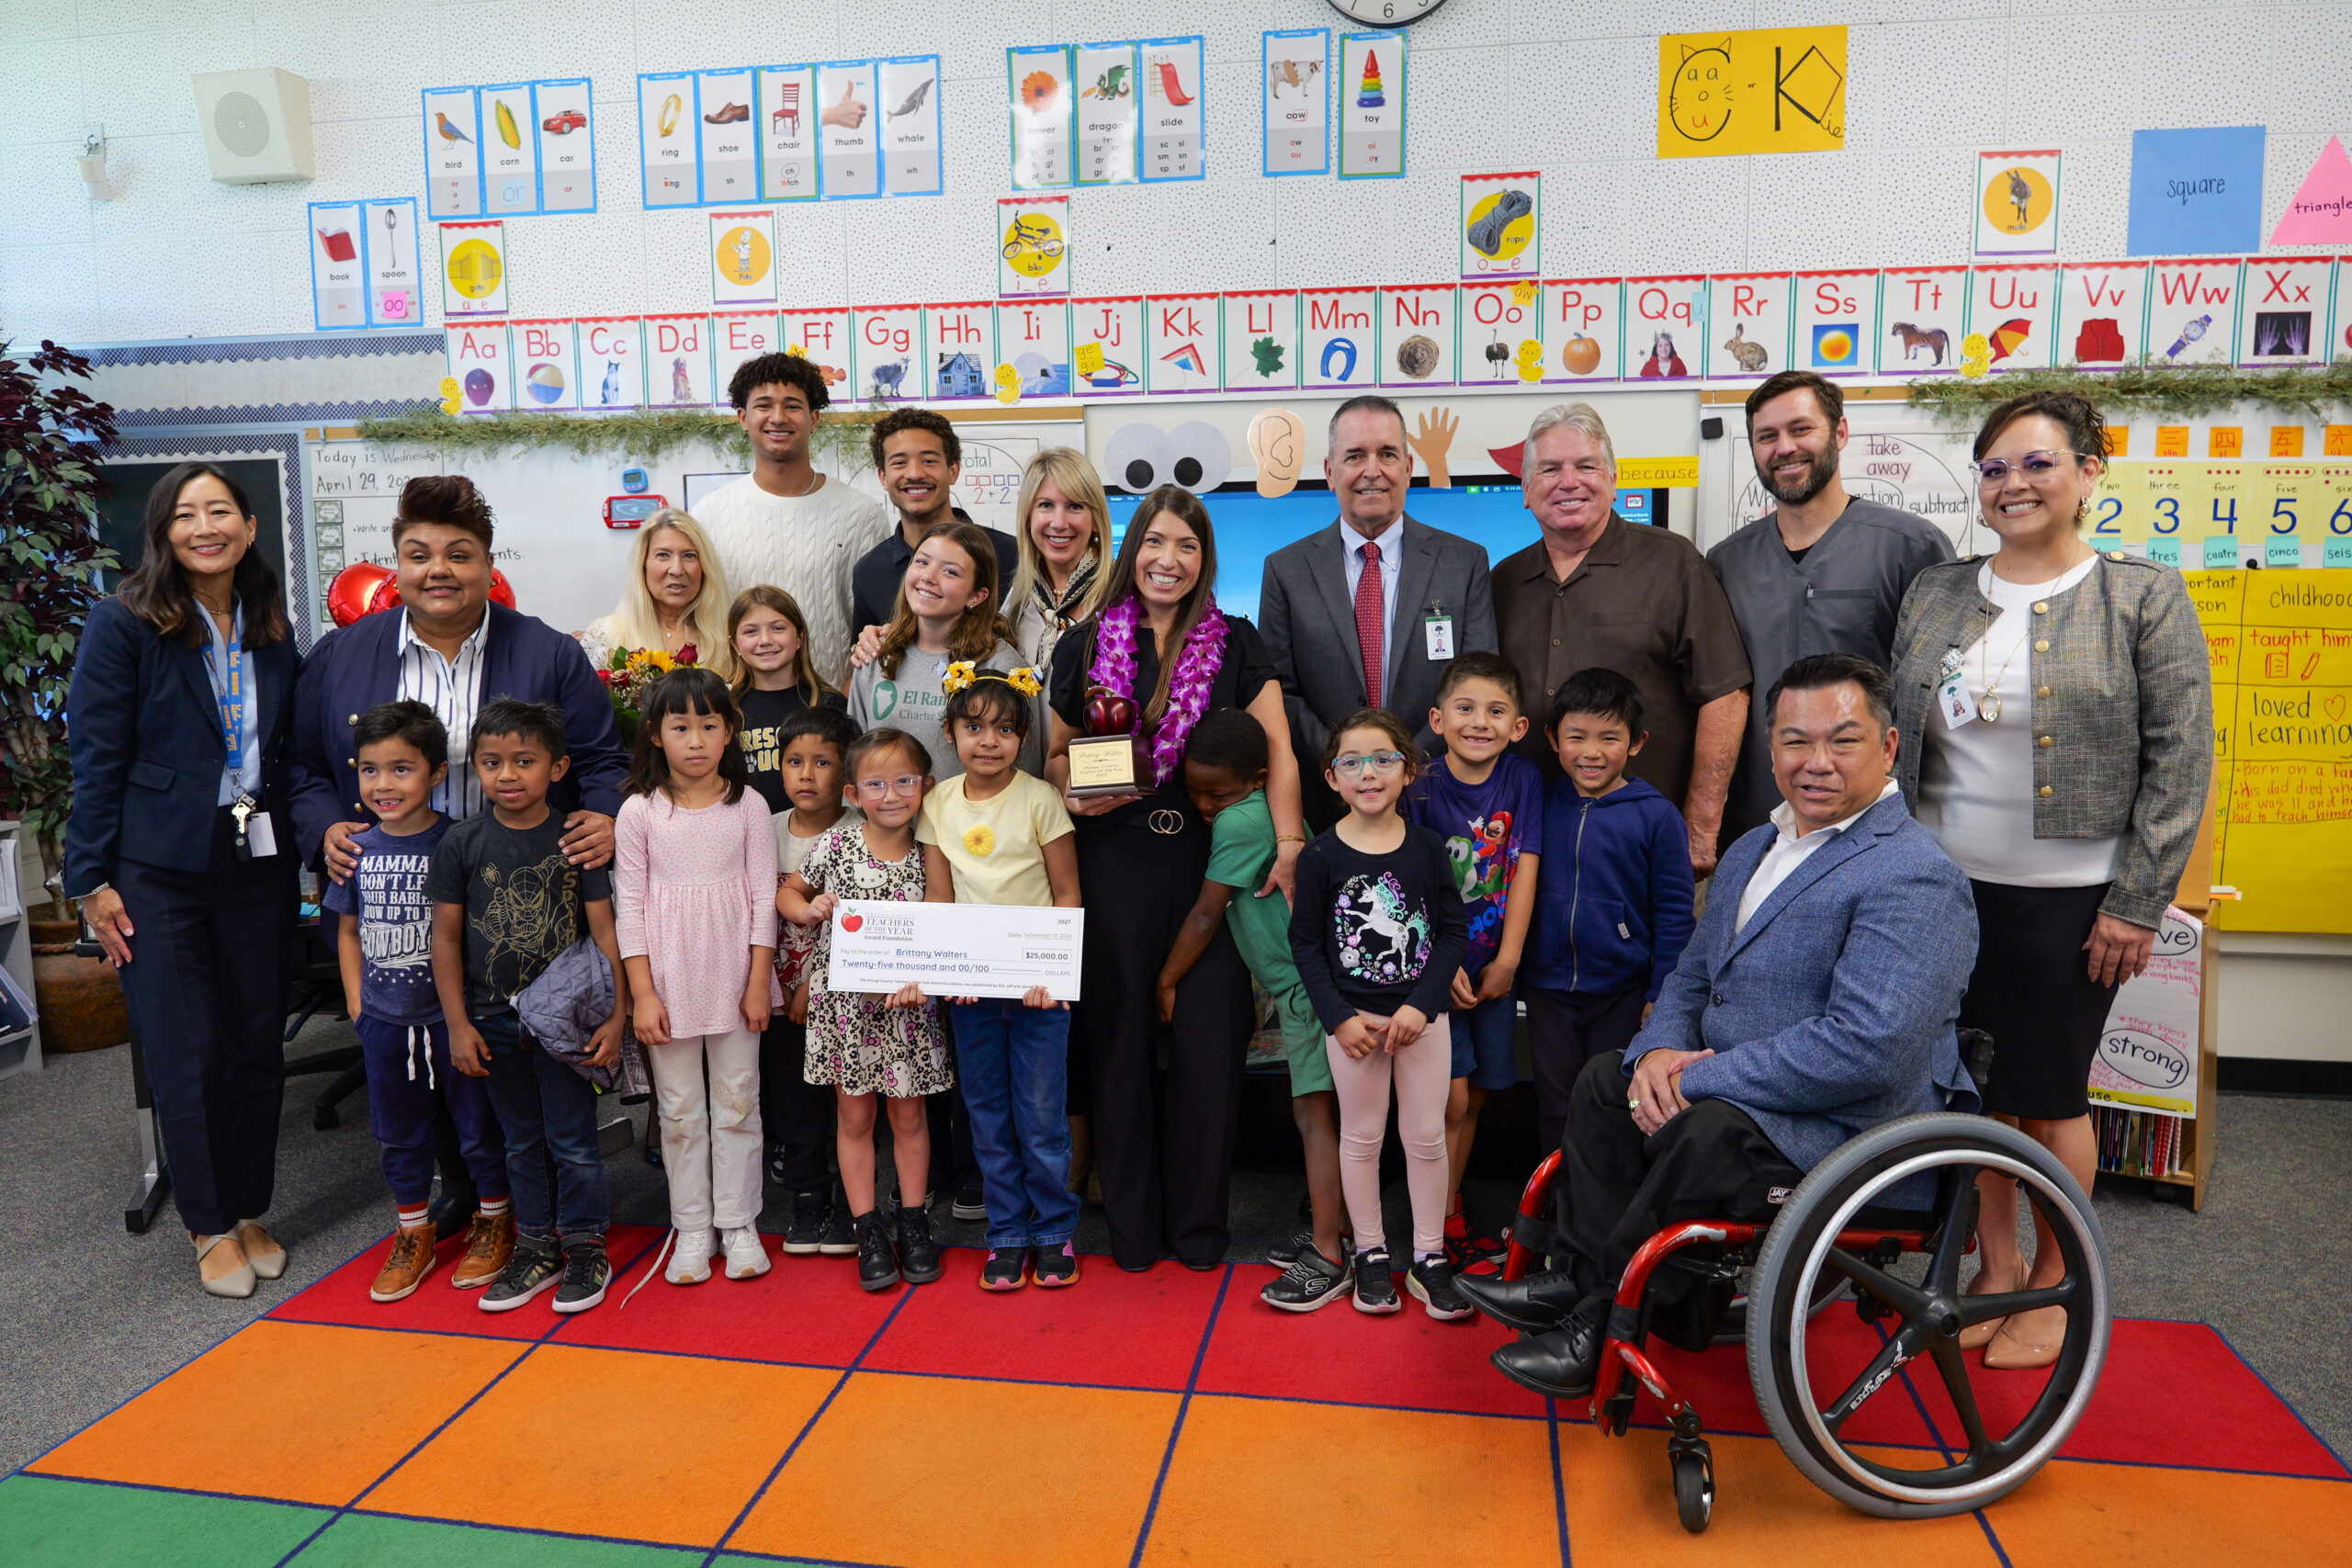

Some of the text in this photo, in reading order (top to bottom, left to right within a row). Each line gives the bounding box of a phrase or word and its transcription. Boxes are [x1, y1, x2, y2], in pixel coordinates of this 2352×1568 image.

[1383, 2, 1395, 18] 6
[1159, 118, 1183, 127] slide
[1286, 112, 1306, 120] cow
[1364, 113, 1381, 124] toy
[1089, 121, 1125, 131] dragon
[777, 141, 800, 151] chair
[835, 138, 864, 147] thumb
[898, 134, 925, 143] whale
[1290, 139, 1303, 147] ow
[662, 149, 679, 158] ring
[718, 143, 739, 153] shoe
[1158, 152, 1188, 161] sm sn
[445, 161, 462, 169] bird
[500, 158, 520, 166] corn
[560, 154, 574, 163] car
[785, 167, 795, 175] ch
[846, 169, 854, 177] th
[1159, 164, 1170, 174] sp
[503, 185, 526, 202] or
[2165, 175, 2227, 206] square
[2293, 194, 2352, 219] triangle
[2007, 223, 2028, 232] mule
[1506, 235, 1526, 246] rope
[330, 273, 350, 281] book
[381, 270, 407, 279] spoon
[1905, 278, 1943, 312] Tt
[1988, 276, 2039, 310] Uu
[2081, 274, 2126, 309] Vv
[2160, 271, 2233, 306] Ww
[2261, 269, 2312, 304] Xx
[1733, 285, 1769, 318] Rr
[1815, 282, 1858, 316] Ss
[1311, 299, 1371, 331] Mm
[1395, 296, 1441, 328] Nn
[1474, 292, 1523, 325] Oo
[1562, 290, 1603, 331] Pp
[1638, 288, 1692, 328] Qq
[1023, 310, 1041, 341] Ii
[1162, 306, 1204, 338] Kk
[1247, 302, 1272, 334] Ll
[729, 321, 765, 351] Ee
[803, 321, 833, 351] Ff
[865, 315, 910, 353] Gg
[939, 314, 981, 344] Hh
[1093, 309, 1121, 347] Jj
[460, 332, 497, 360] Aa
[526, 329, 561, 358] Bb
[590, 326, 628, 356] Cc
[658, 323, 698, 354] Dd
[1866, 434, 1901, 456] take
[2159, 430, 2181, 446] 三
[2215, 431, 2235, 449] 四
[2274, 431, 2294, 447] 五
[2331, 428, 2349, 446] 六
[313, 448, 357, 468] Today
[365, 451, 378, 463] is
[1620, 463, 1699, 481] because
[1866, 462, 1911, 484] away
[316, 472, 379, 495] April 29,
[2149, 480, 2181, 491] three
[2212, 481, 2238, 492] four
[2276, 483, 2299, 494] five
[974, 486, 1012, 504] 2 2
[1909, 491, 1970, 515] subtract
[2096, 497, 2352, 535] 2 3 4 5 6
[356, 524, 378, 534] Write
[2150, 547, 2178, 564] tres
[2206, 548, 2237, 562] cuatro
[2268, 546, 2300, 558] cinco
[2249, 628, 2313, 658] taught
[902, 690, 922, 706] El
[2254, 690, 2312, 719] loved
[899, 708, 935, 722] Charter
[2243, 760, 2324, 777] Born on a
[2241, 780, 2260, 798] His
[2267, 777, 2290, 795] dad
[2297, 778, 2324, 795] died
[2237, 795, 2335, 810] he was and
[2233, 809, 2252, 824] had
[2275, 808, 2308, 823] teach
[359, 874, 402, 890] DON'T
[361, 890, 387, 905] YOUR
[387, 906, 420, 920] UP TO
[865, 917, 915, 927] TEACHERS
[888, 926, 914, 936] YEAR
[896, 948, 968, 959] Brittany Walters
[1025, 952, 1069, 961] $25,000.00
[842, 959, 989, 974] Twenty-five thousand and 00/100
[2158, 1022, 2188, 1040] knock
[2109, 1036, 2185, 1085] strong
[1770, 1188, 1787, 1198] JAY
